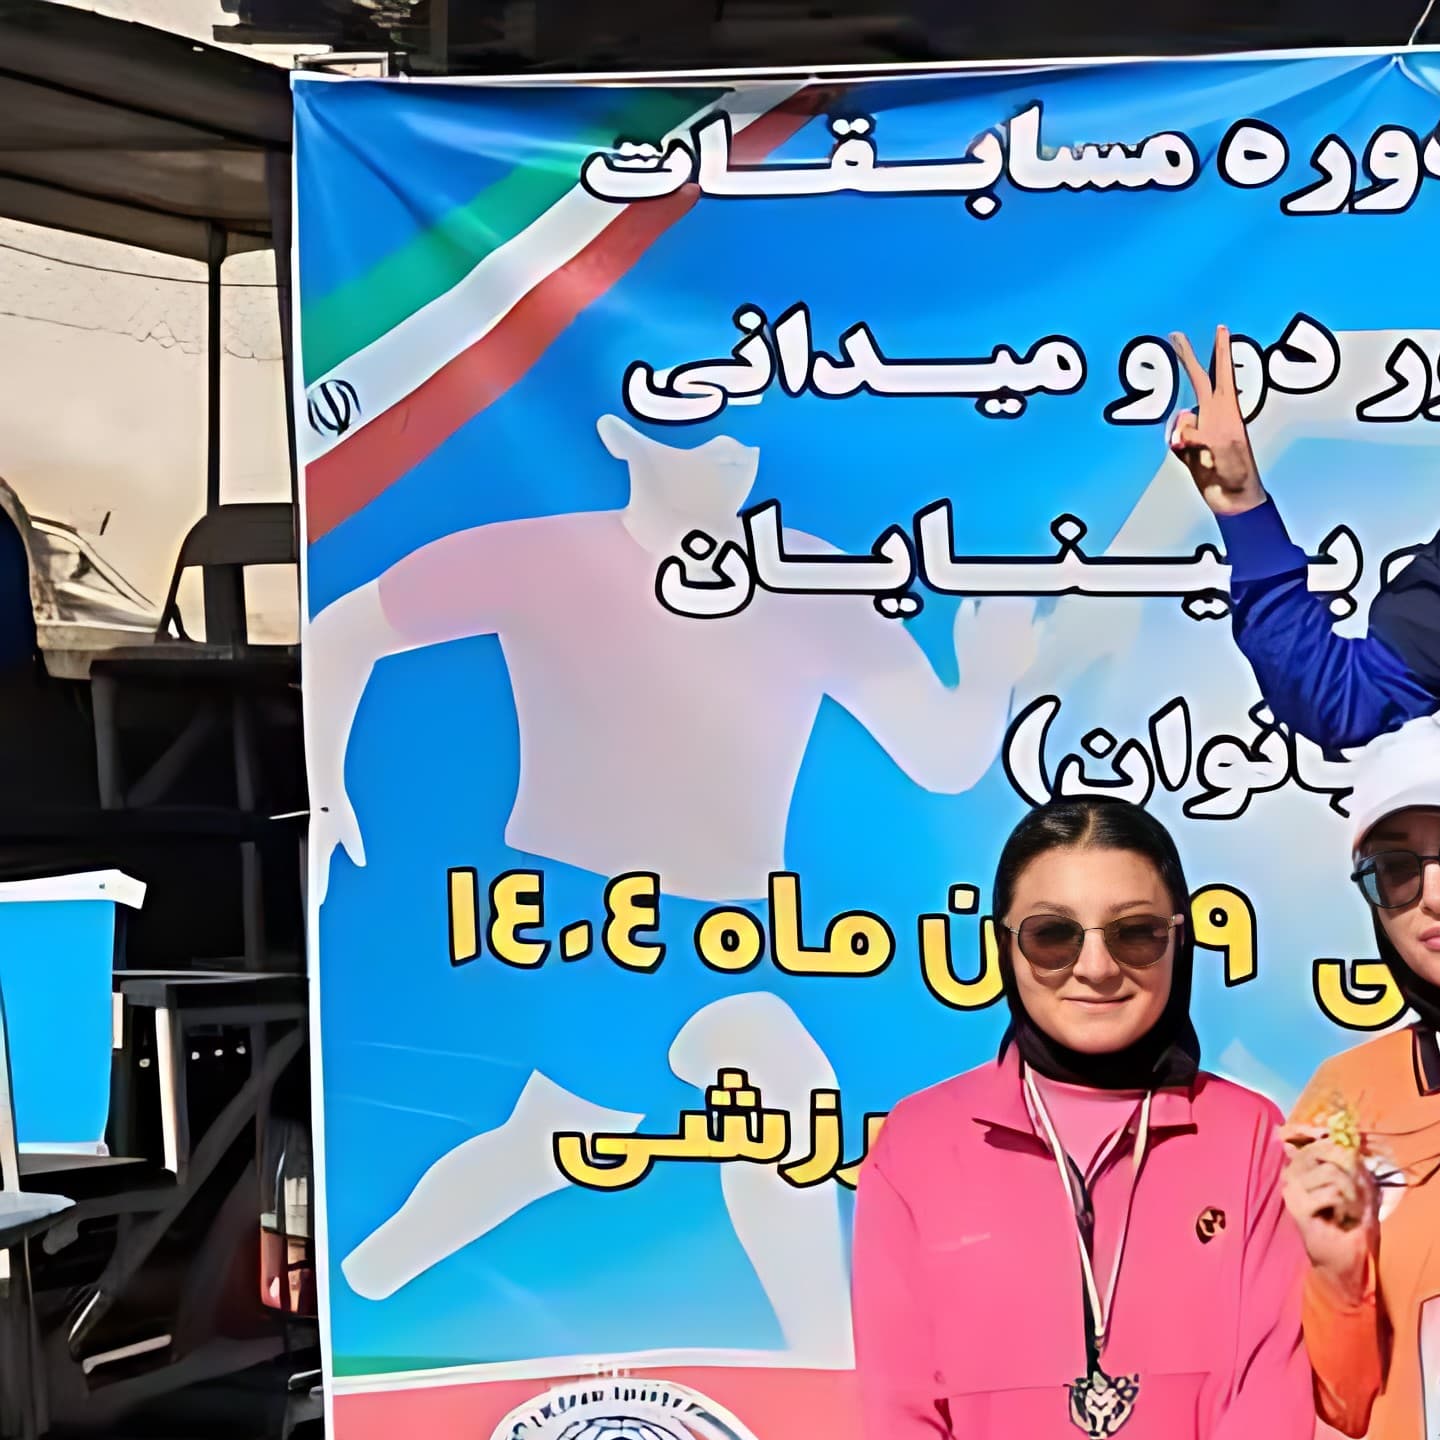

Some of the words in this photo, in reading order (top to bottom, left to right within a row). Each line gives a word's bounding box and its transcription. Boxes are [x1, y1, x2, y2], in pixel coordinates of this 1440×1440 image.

[580, 100, 1200, 220] مسابقات
[622, 300, 1088, 424] میدانی
[692, 869, 896, 977] ماه
